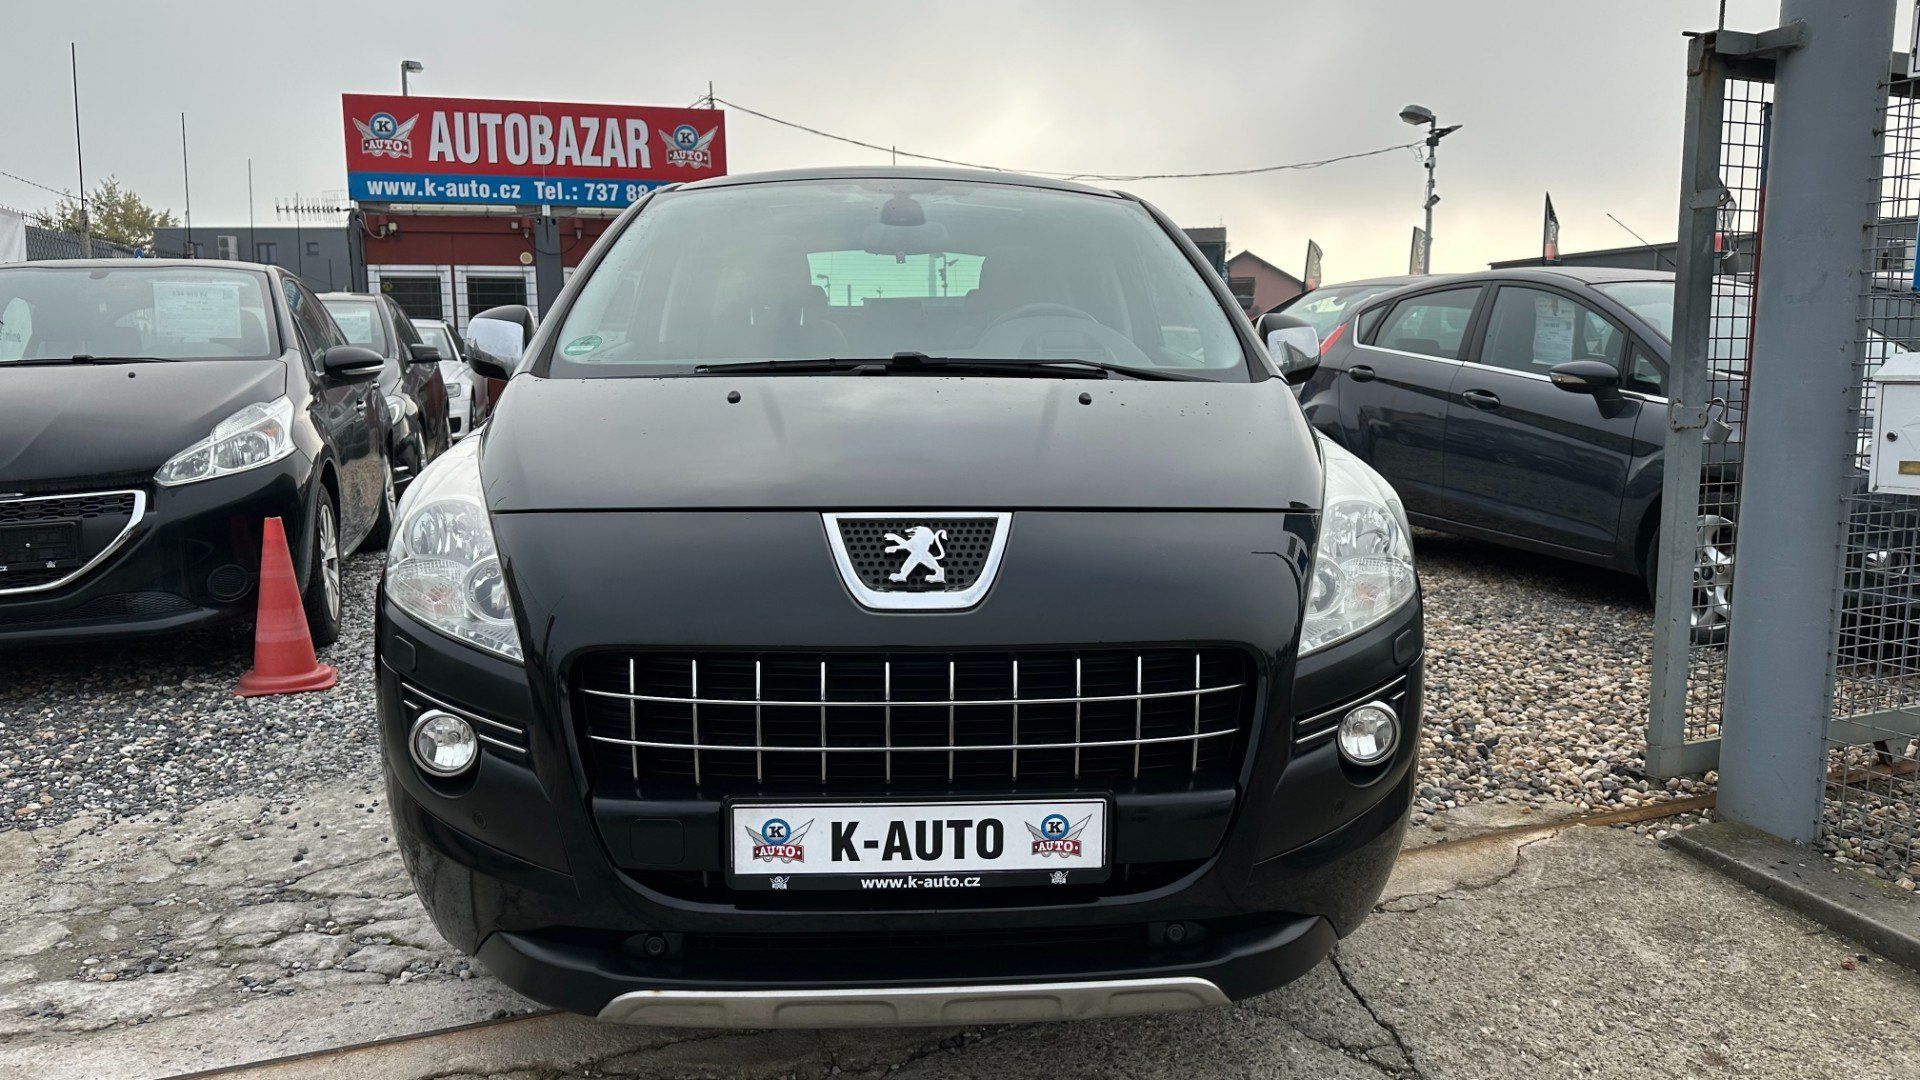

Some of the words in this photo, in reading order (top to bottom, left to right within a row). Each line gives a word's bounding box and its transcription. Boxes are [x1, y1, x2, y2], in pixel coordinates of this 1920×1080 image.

[376, 120, 391, 133] K
[428, 110, 652, 168] AUTOBAZAR
[680, 132, 693, 144] K
[369, 139, 403, 151] AUTO
[673, 151, 704, 162] AUTO
[367, 178, 521, 199] www.k-auto.cz
[534, 181, 578, 200] Tel.:
[584, 183, 619, 201] 737
[769, 826, 784, 838] K
[1048, 821, 1062, 833] K
[831, 818, 1004, 862] K-AUTO
[1037, 840, 1073, 852] AUTO
[758, 845, 796, 857] AUTO
[861, 875, 981, 889] www.k-auto.cz
